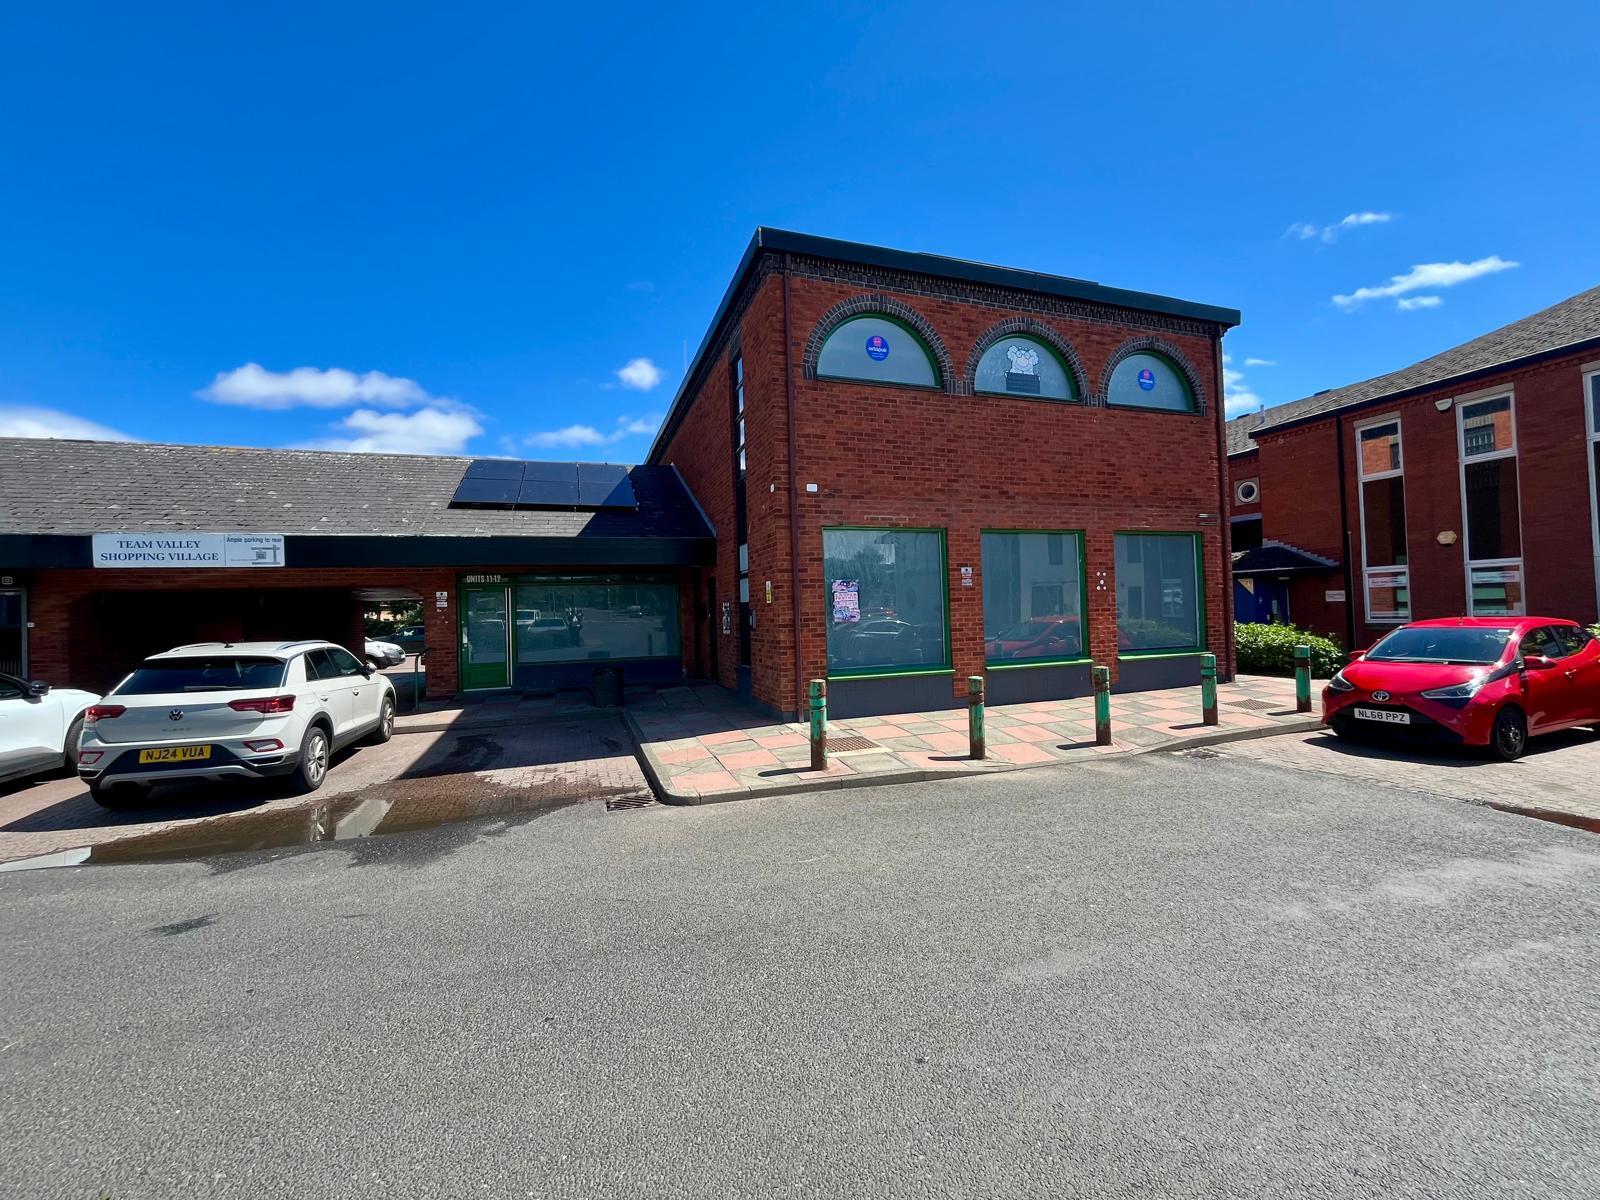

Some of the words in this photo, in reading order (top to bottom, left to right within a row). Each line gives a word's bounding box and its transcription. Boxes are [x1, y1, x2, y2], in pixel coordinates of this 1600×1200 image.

[117, 540, 152, 549] TEAM
[155, 540, 200, 549] VALLEY
[100, 552, 165, 562] SHOPPING
[168, 552, 219, 561] VILLAGE
[466, 575, 485, 583] UNITS
[1358, 709, 1383, 720] NL68
[1385, 712, 1406, 722] PPZ
[145, 749, 177, 761] NJ24
[181, 746, 205, 758] VUA
